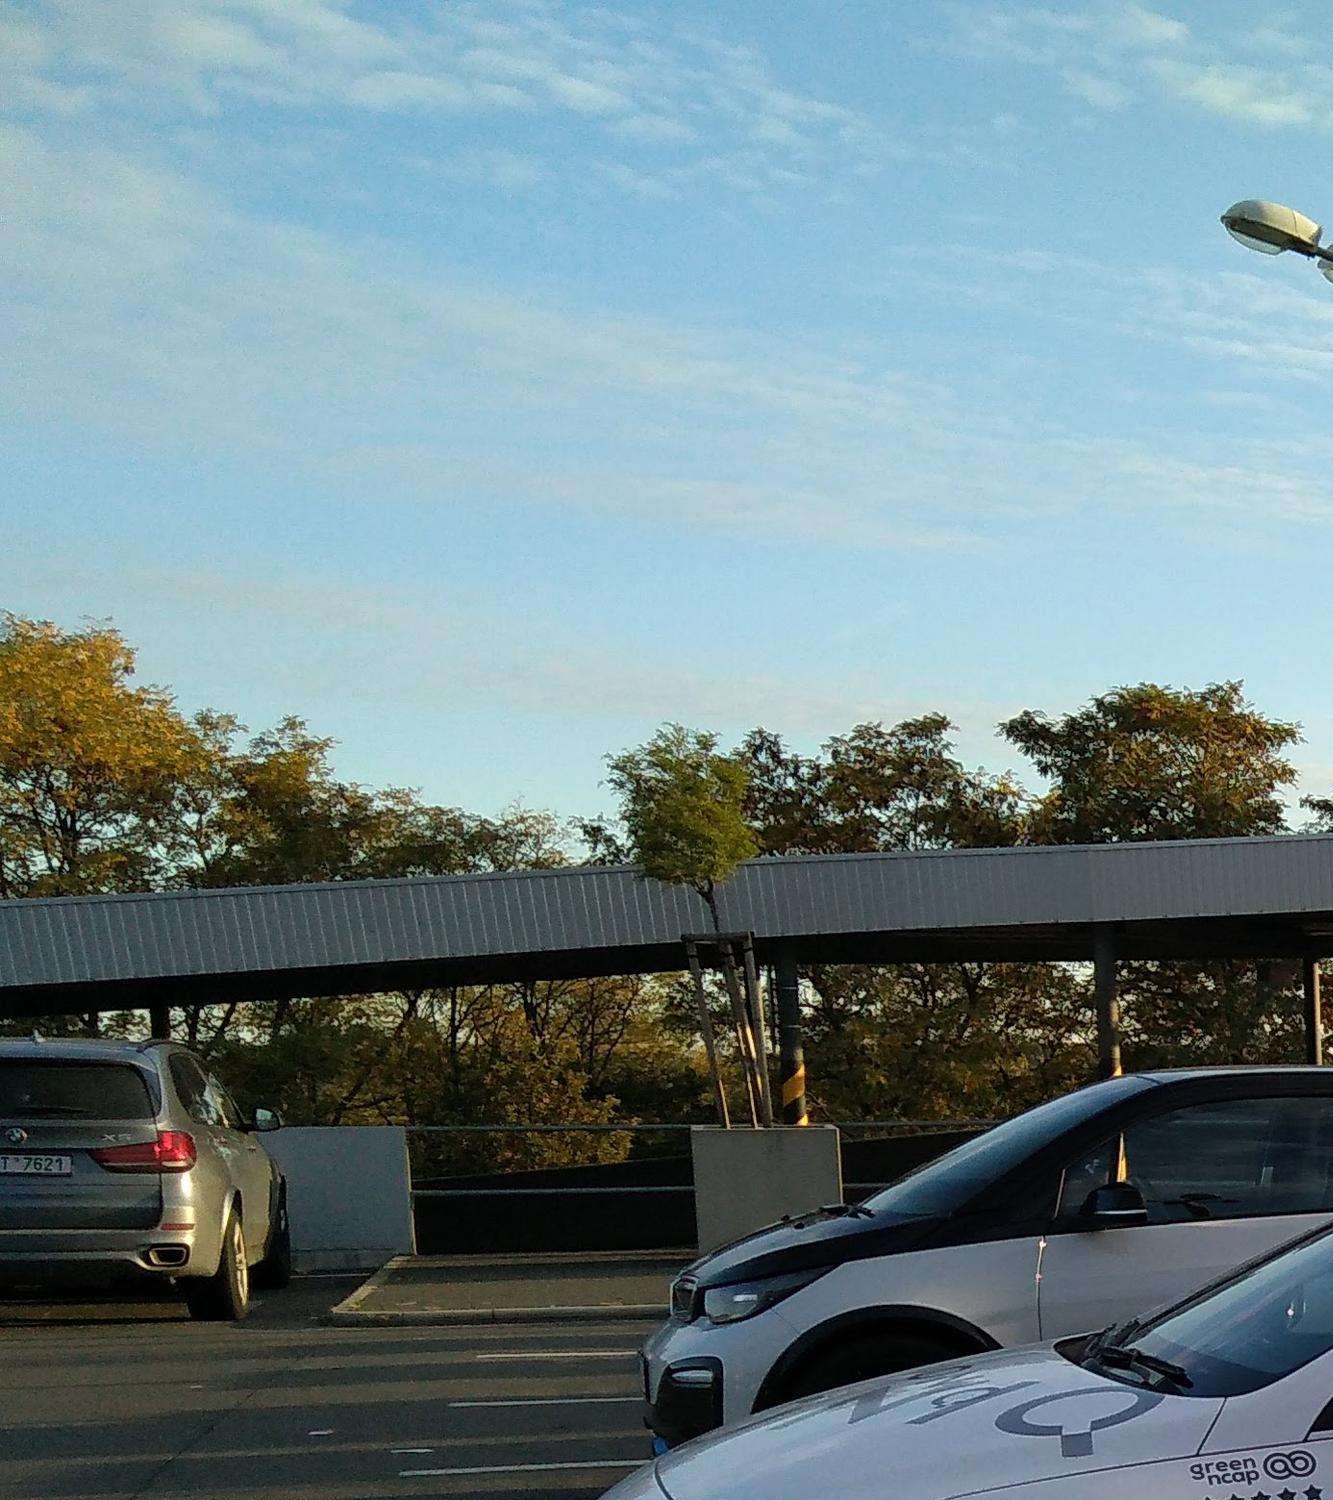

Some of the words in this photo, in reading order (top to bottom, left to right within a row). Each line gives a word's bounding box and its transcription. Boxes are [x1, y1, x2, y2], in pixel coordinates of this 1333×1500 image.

[23, 1157, 64, 1171] 7621
[1190, 1457, 1257, 1481] green
[1208, 1469, 1260, 1486] ncap
